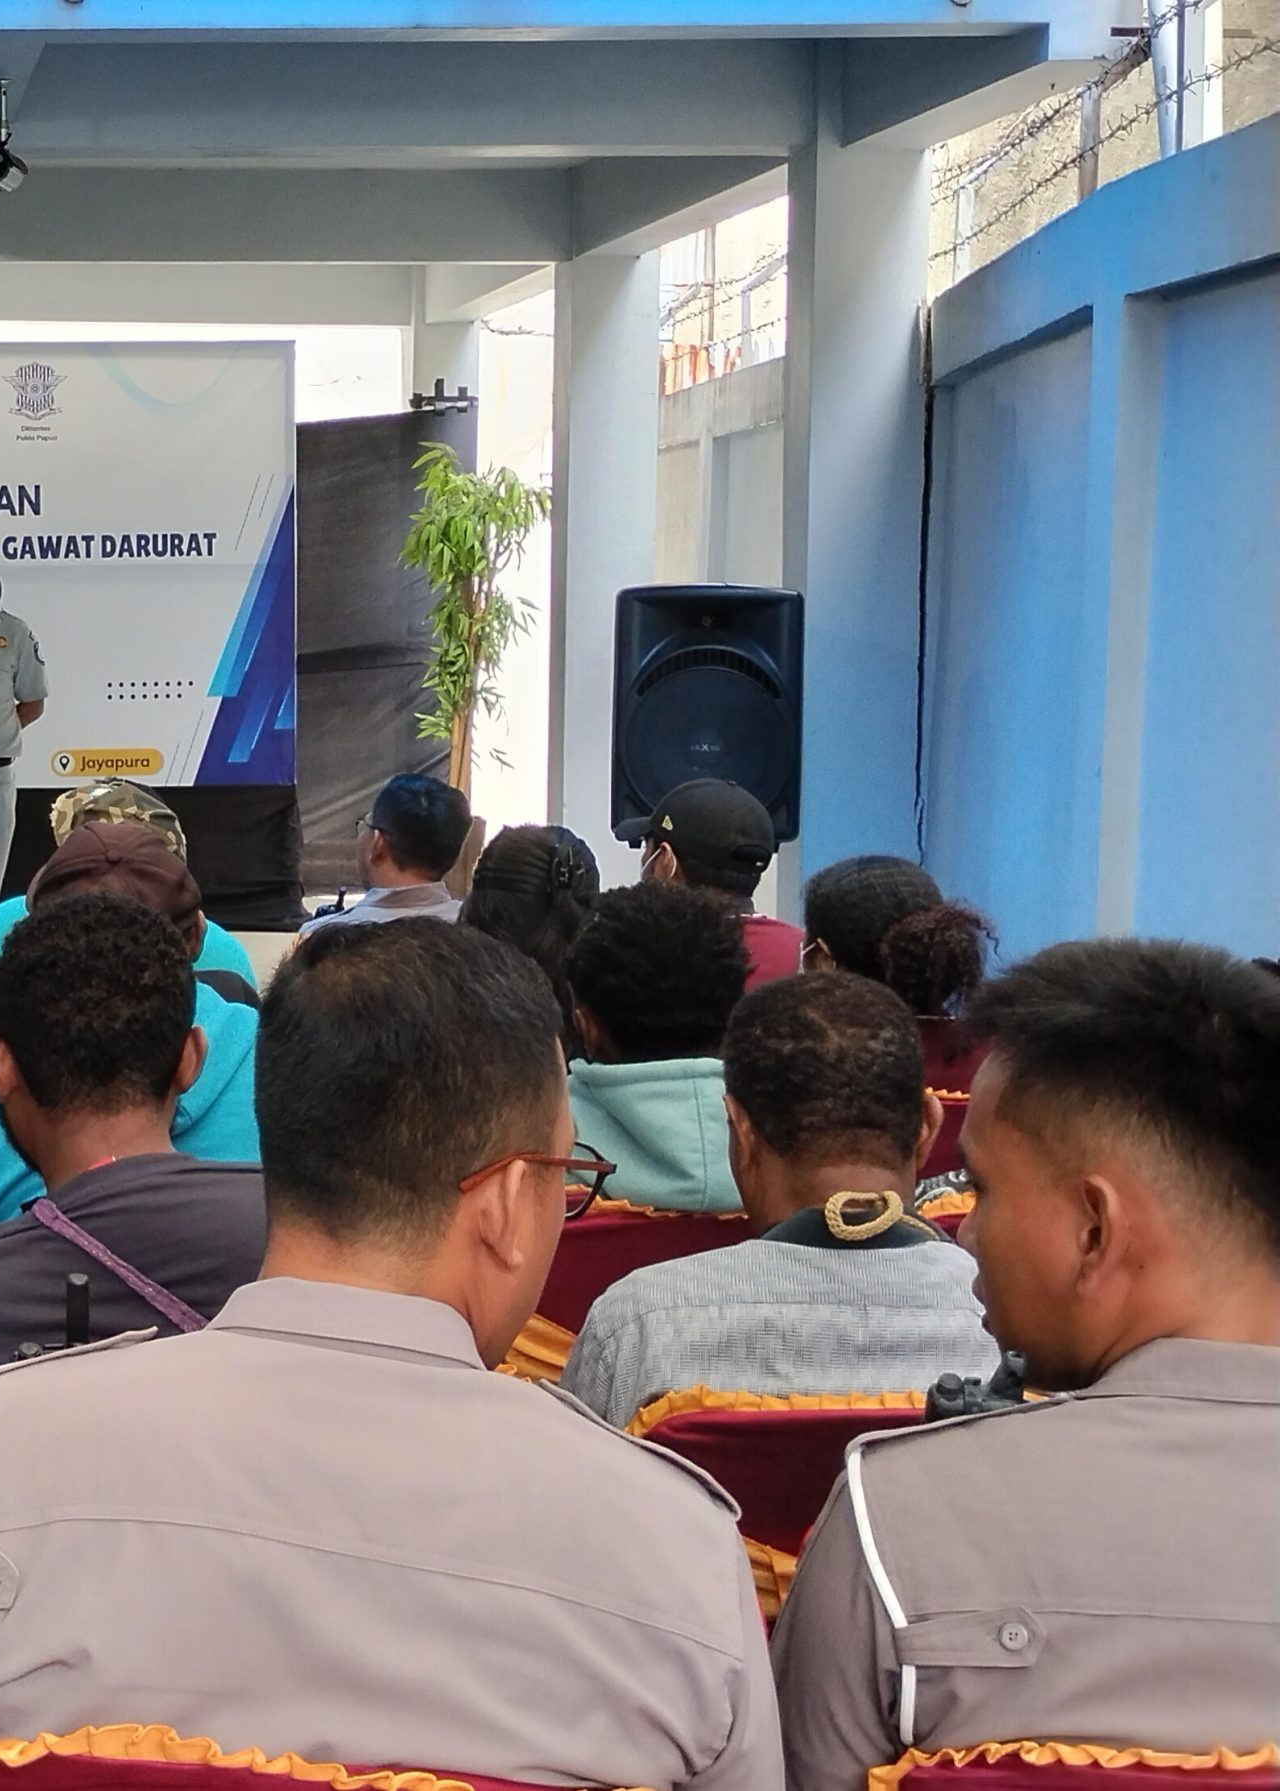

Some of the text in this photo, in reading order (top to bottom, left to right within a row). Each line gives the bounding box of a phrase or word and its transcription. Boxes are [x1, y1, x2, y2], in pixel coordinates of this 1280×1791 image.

[1, 535, 95, 560] GAWAT
[101, 532, 217, 558] DARURAT
[80, 756, 150, 772] Jayapura
